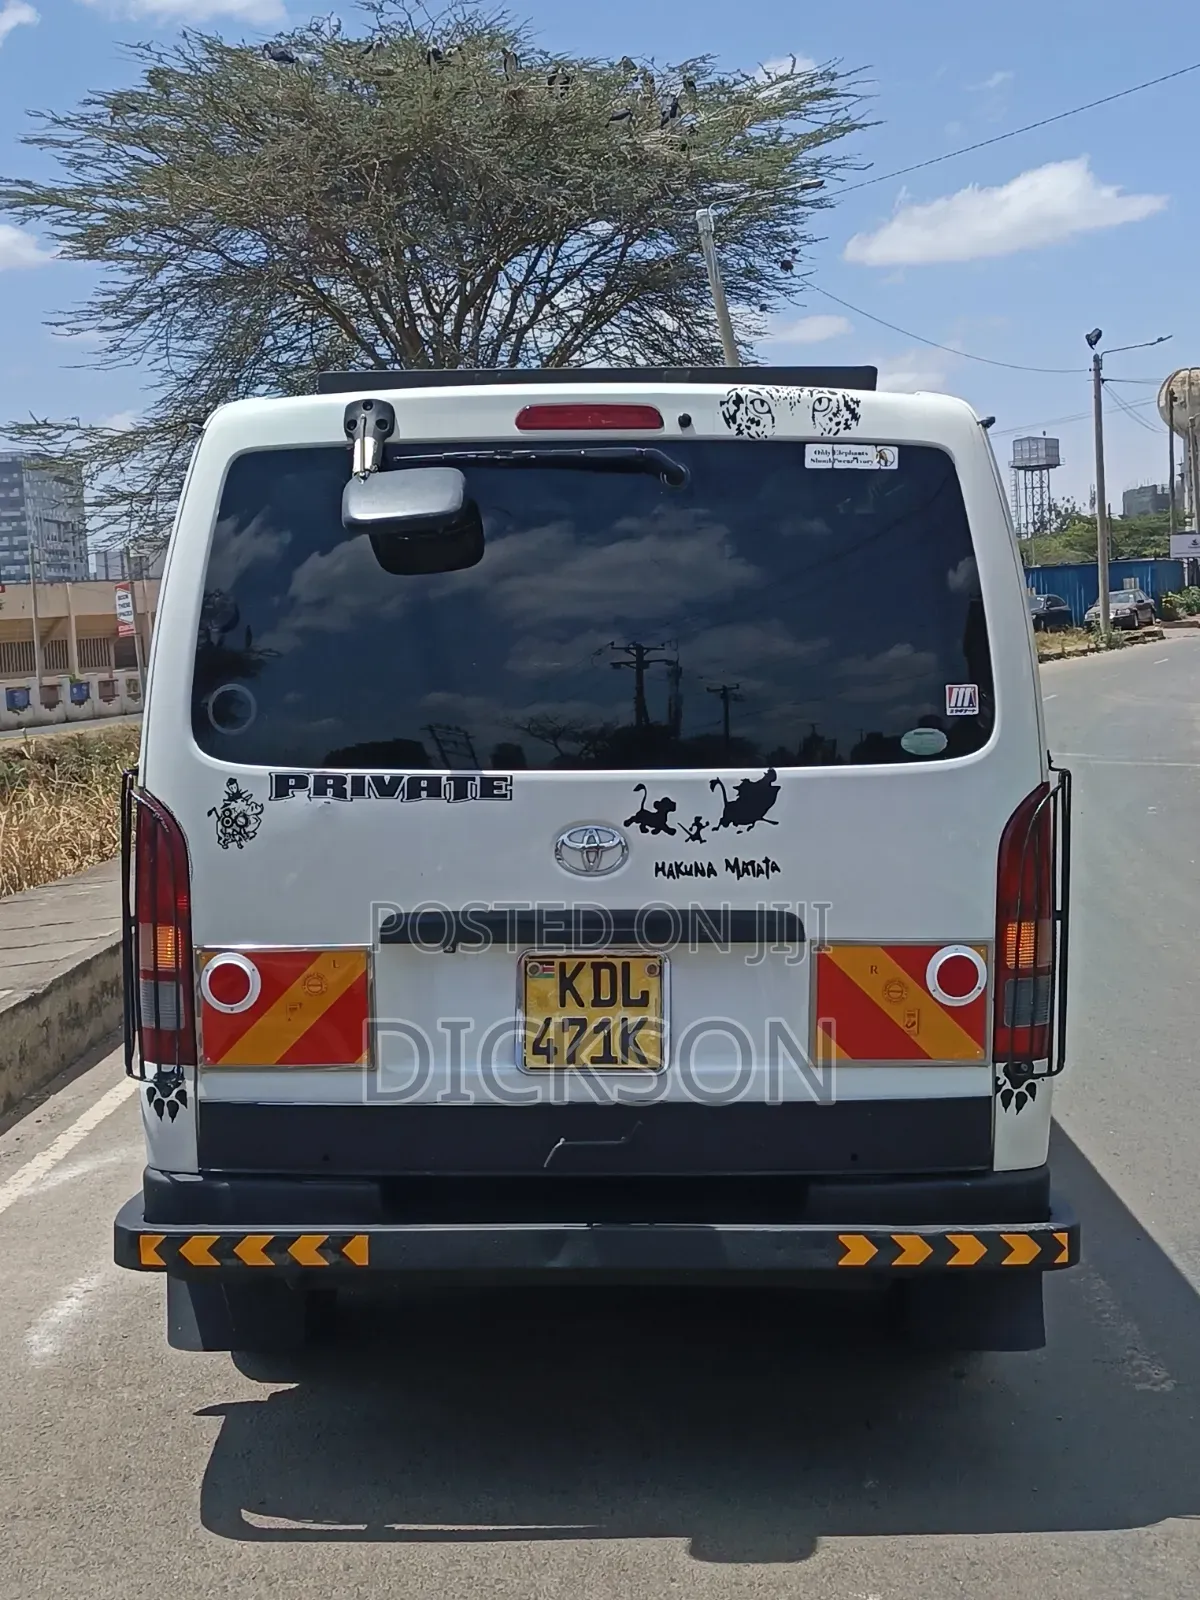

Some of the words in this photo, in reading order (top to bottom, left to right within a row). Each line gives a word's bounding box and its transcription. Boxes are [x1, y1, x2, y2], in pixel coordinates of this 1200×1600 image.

[269, 772, 513, 803] PRIVATE
[654, 861, 718, 880] HAKUNA
[724, 856, 781, 881] MATATA
[558, 961, 650, 1008] KDL
[532, 1016, 649, 1065] 471K
